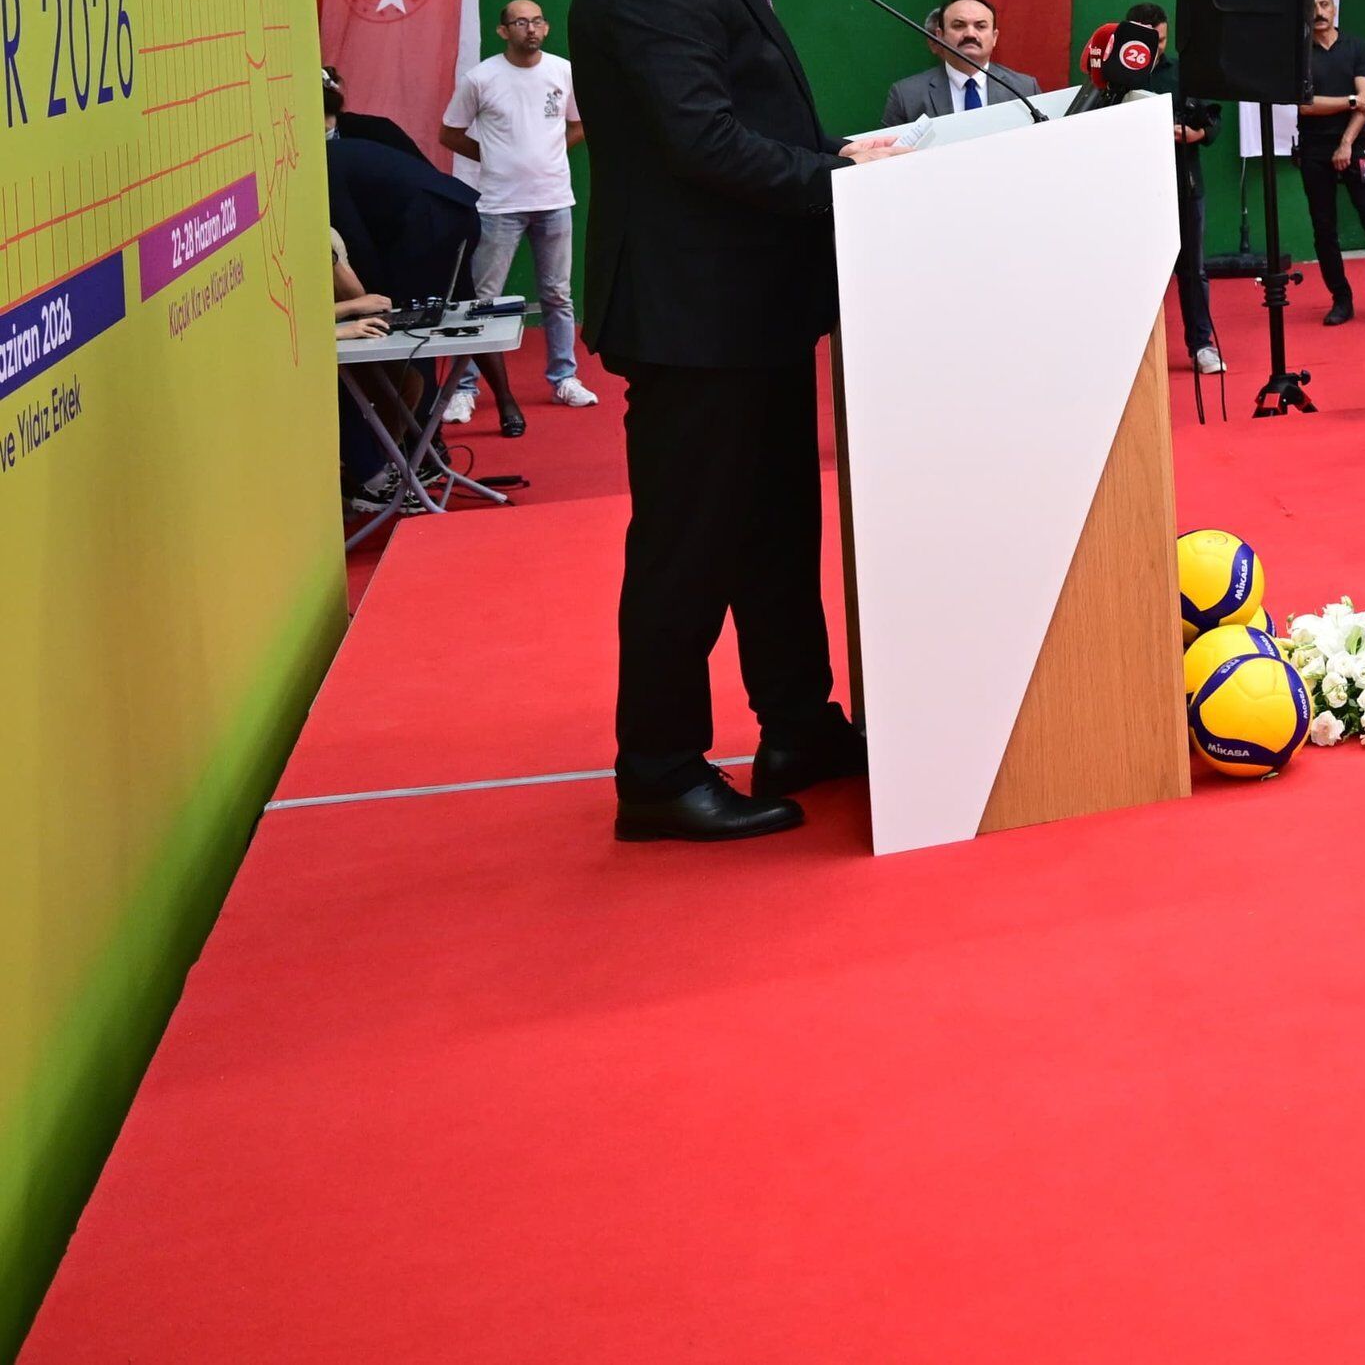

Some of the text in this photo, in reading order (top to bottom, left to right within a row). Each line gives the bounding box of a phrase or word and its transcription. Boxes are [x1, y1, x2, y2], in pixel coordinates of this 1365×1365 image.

[1126, 49, 1146, 64] 26
[171, 195, 237, 269] 22-28 Haziran 2026
[41, 293, 72, 356] 2026
[168, 293, 191, 342] Küçük
[210, 266, 230, 310] Küçük
[229, 252, 245, 292] Erkek
[17, 401, 51, 458] Yıldız
[52, 374, 82, 434] Erkek
